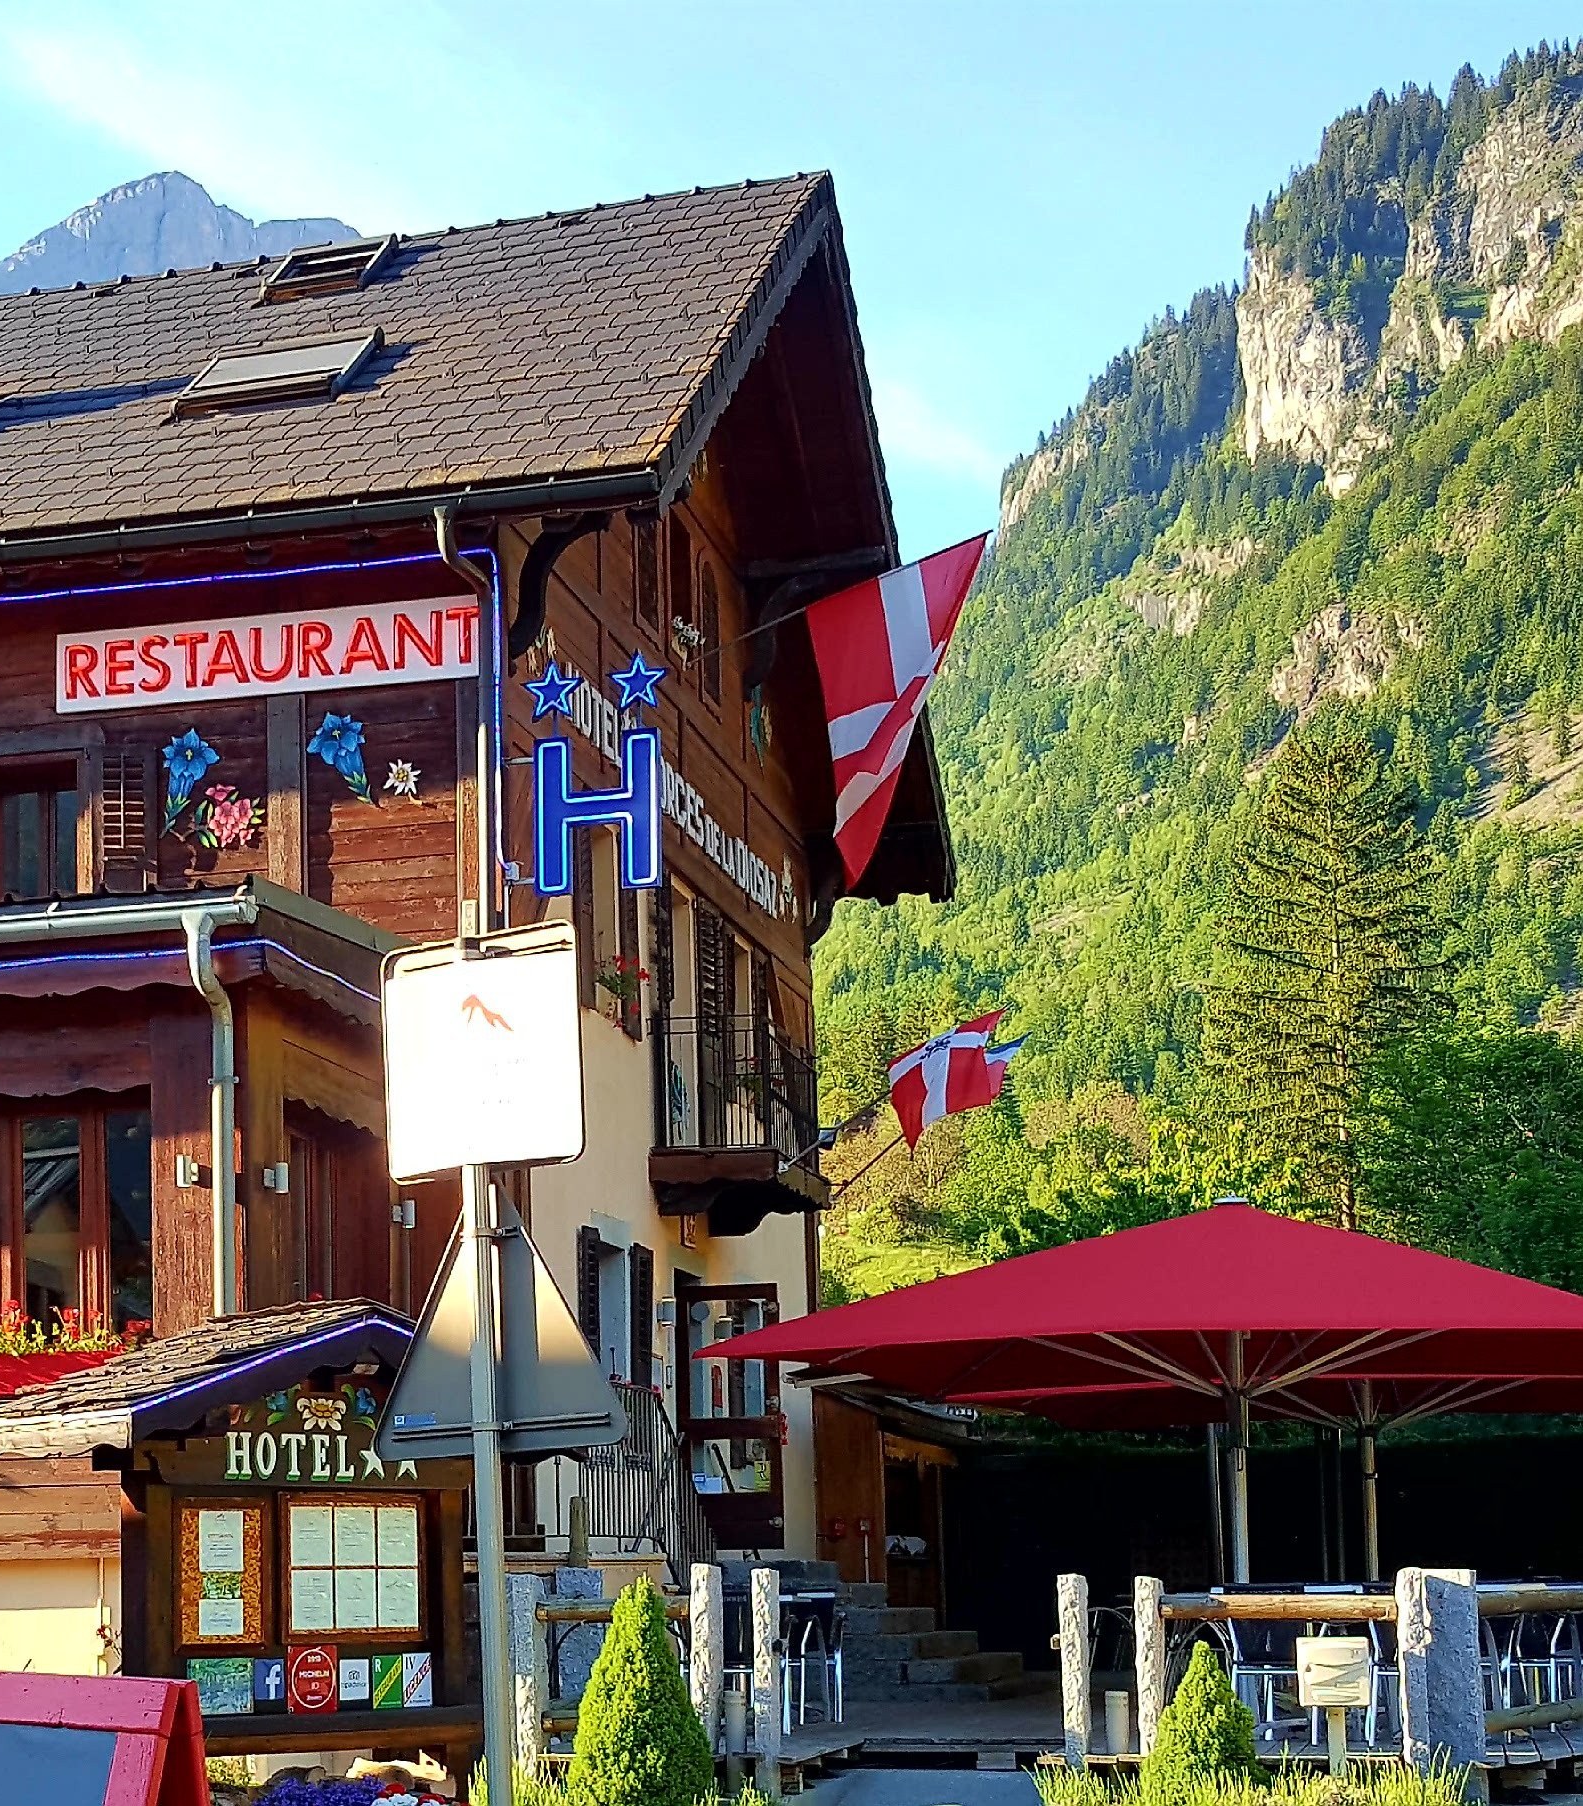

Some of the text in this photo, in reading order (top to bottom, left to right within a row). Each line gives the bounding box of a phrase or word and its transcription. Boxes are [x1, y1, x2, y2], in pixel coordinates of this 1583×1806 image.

[65, 606, 480, 701] RESTAURANT
[534, 727, 662, 895] H
[224, 1430, 356, 1483] HOTEL
[405, 1656, 416, 1670] IV
